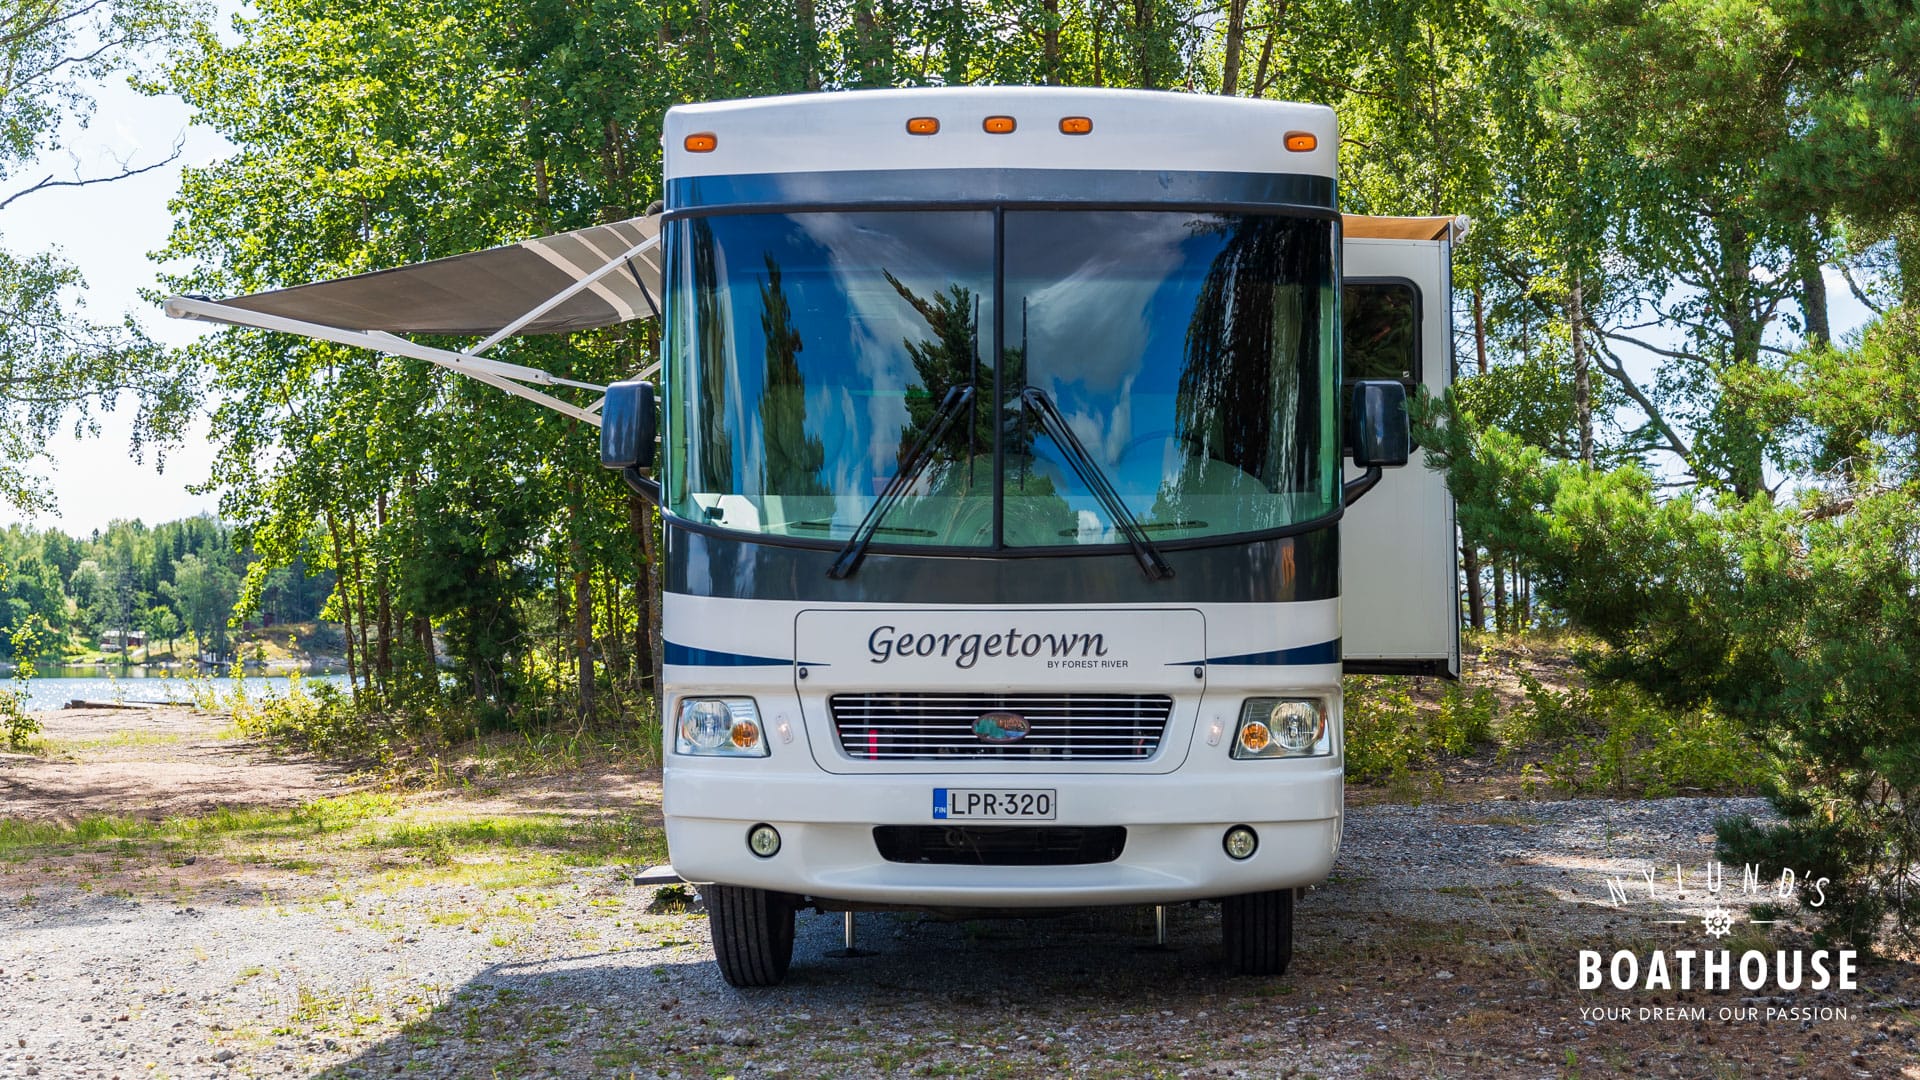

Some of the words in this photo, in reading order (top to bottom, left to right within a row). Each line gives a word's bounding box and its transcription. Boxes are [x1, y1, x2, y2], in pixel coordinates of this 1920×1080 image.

[867, 625, 1109, 670] Georgetown
[1047, 660, 1060, 669] BY
[1062, 660, 1098, 669] FOREST
[1101, 660, 1129, 669] RIVER
[934, 806, 947, 815] FIN
[951, 793, 1050, 816] LPR-320
